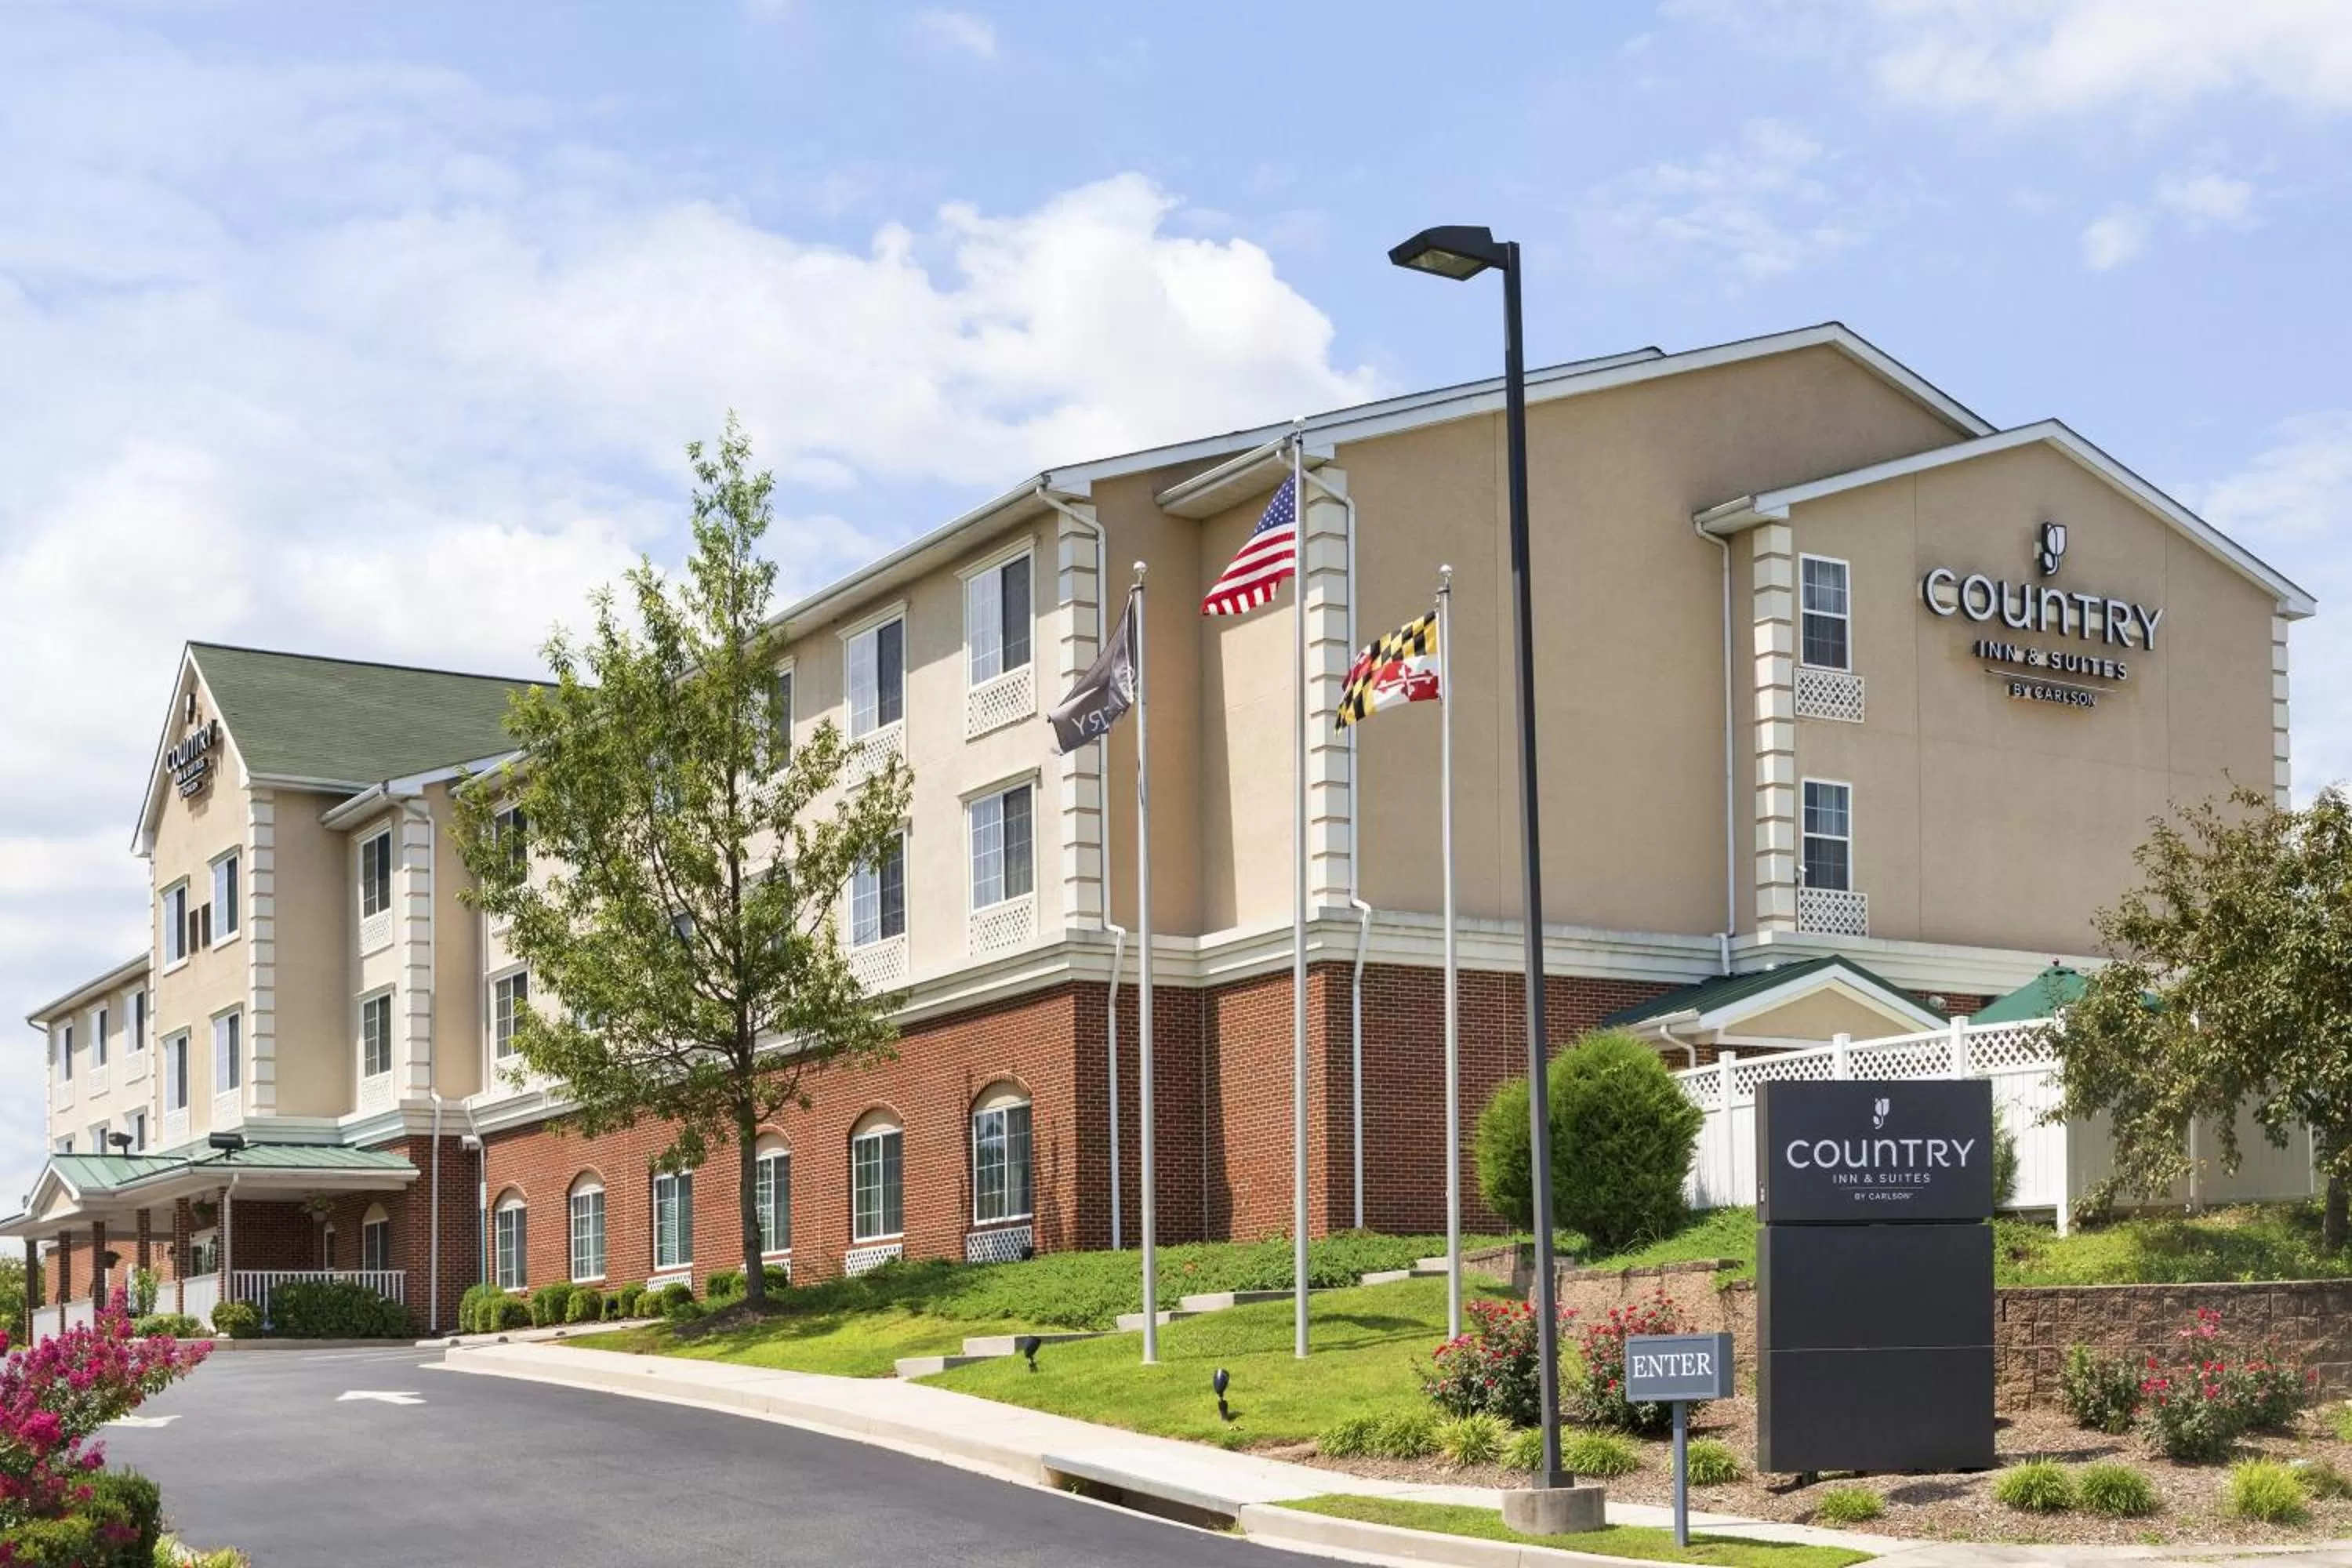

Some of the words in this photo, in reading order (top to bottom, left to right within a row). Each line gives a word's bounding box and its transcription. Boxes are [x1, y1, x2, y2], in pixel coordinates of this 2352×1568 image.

[1922, 568, 2164, 651] COUNTRY
[1975, 639, 2017, 662] INN
[2027, 648, 2039, 666] &
[2050, 651, 2128, 680] SUITES
[2012, 683, 2031, 699] BY
[2034, 685, 2097, 708] CARLSON
[1786, 1138, 1976, 1169] COUNTRY
[1832, 1173, 1857, 1184] INN
[1864, 1173, 1873, 1183] &
[1878, 1172, 1931, 1184] SUITES
[1632, 1352, 1712, 1378] ENTER
